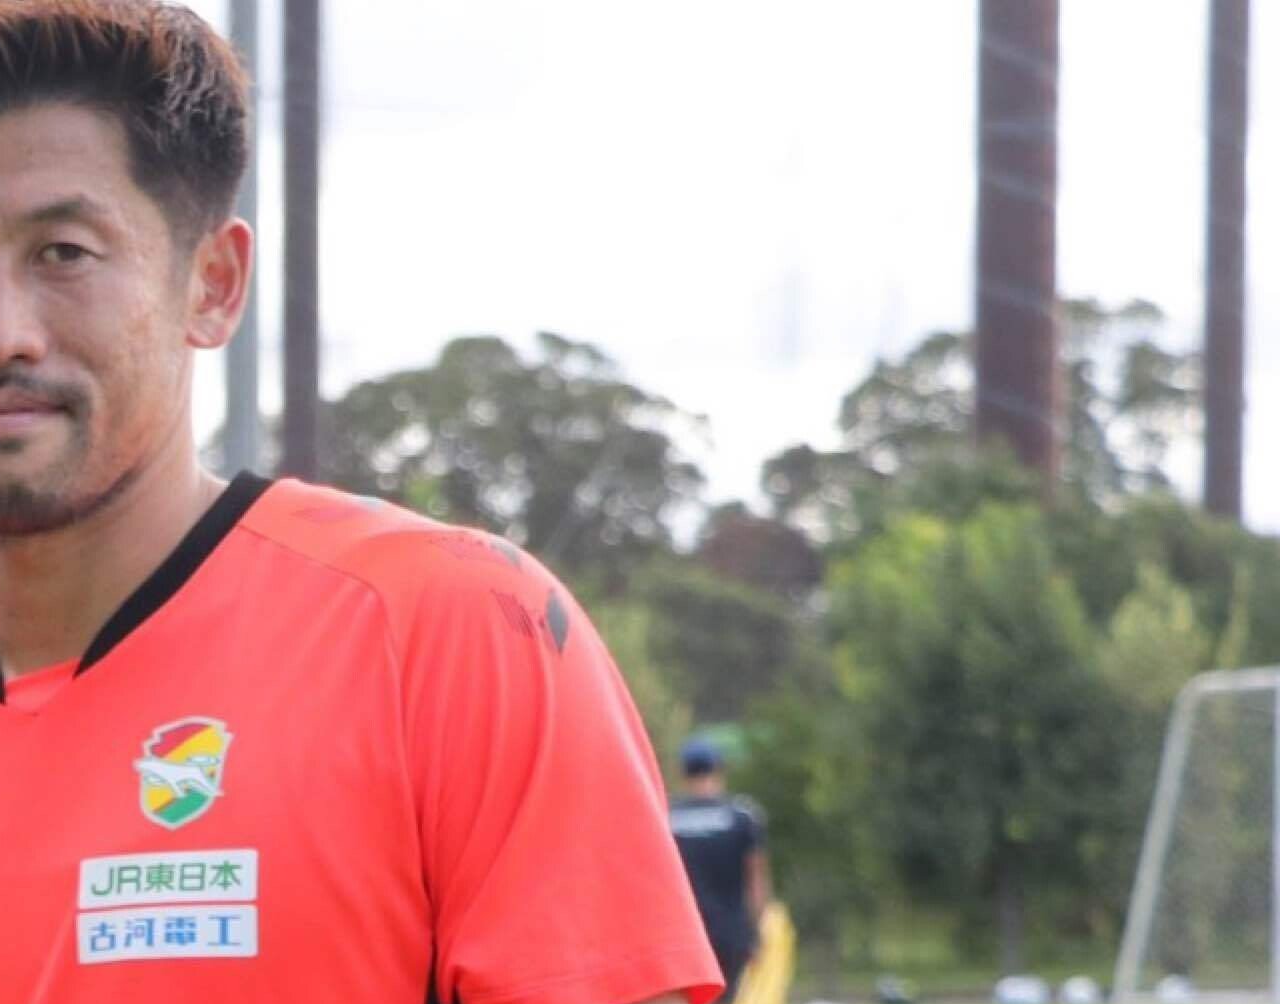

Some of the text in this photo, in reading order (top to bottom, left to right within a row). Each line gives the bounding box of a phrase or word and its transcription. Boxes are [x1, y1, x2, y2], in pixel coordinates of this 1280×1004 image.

[90, 860, 244, 896] JR東日本
[90, 914, 243, 953] 古河電工
